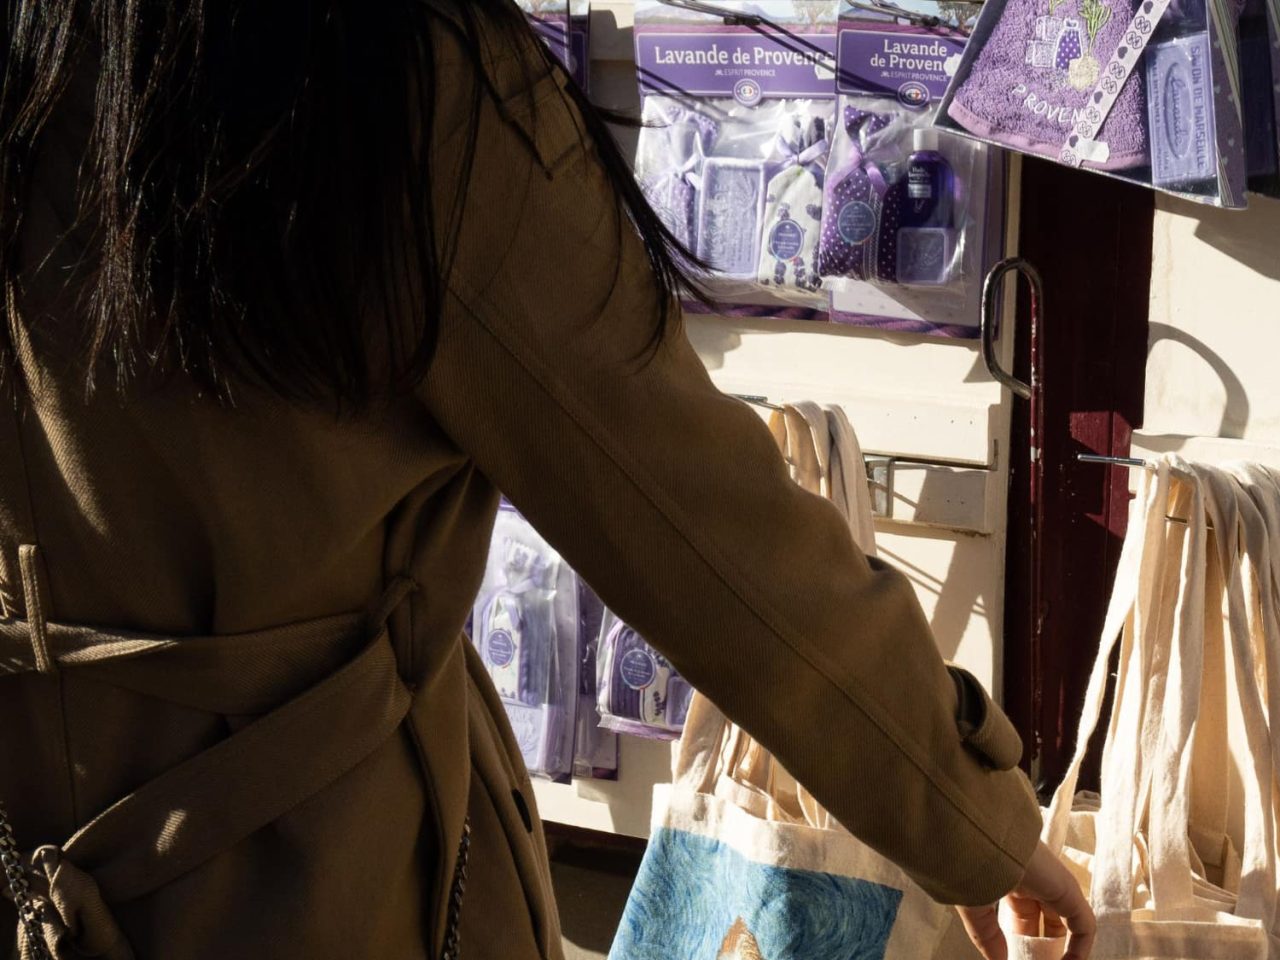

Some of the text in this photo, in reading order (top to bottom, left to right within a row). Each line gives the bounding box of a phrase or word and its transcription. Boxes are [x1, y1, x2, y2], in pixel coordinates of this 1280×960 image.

[655, 44, 728, 64] Lavande
[732, 47, 750, 64] de
[884, 39, 947, 57] Lavande
[870, 53, 945, 71] de Proven
[1011, 83, 1084, 125] PROVEN
[1194, 105, 1207, 168] MARSEILLE
